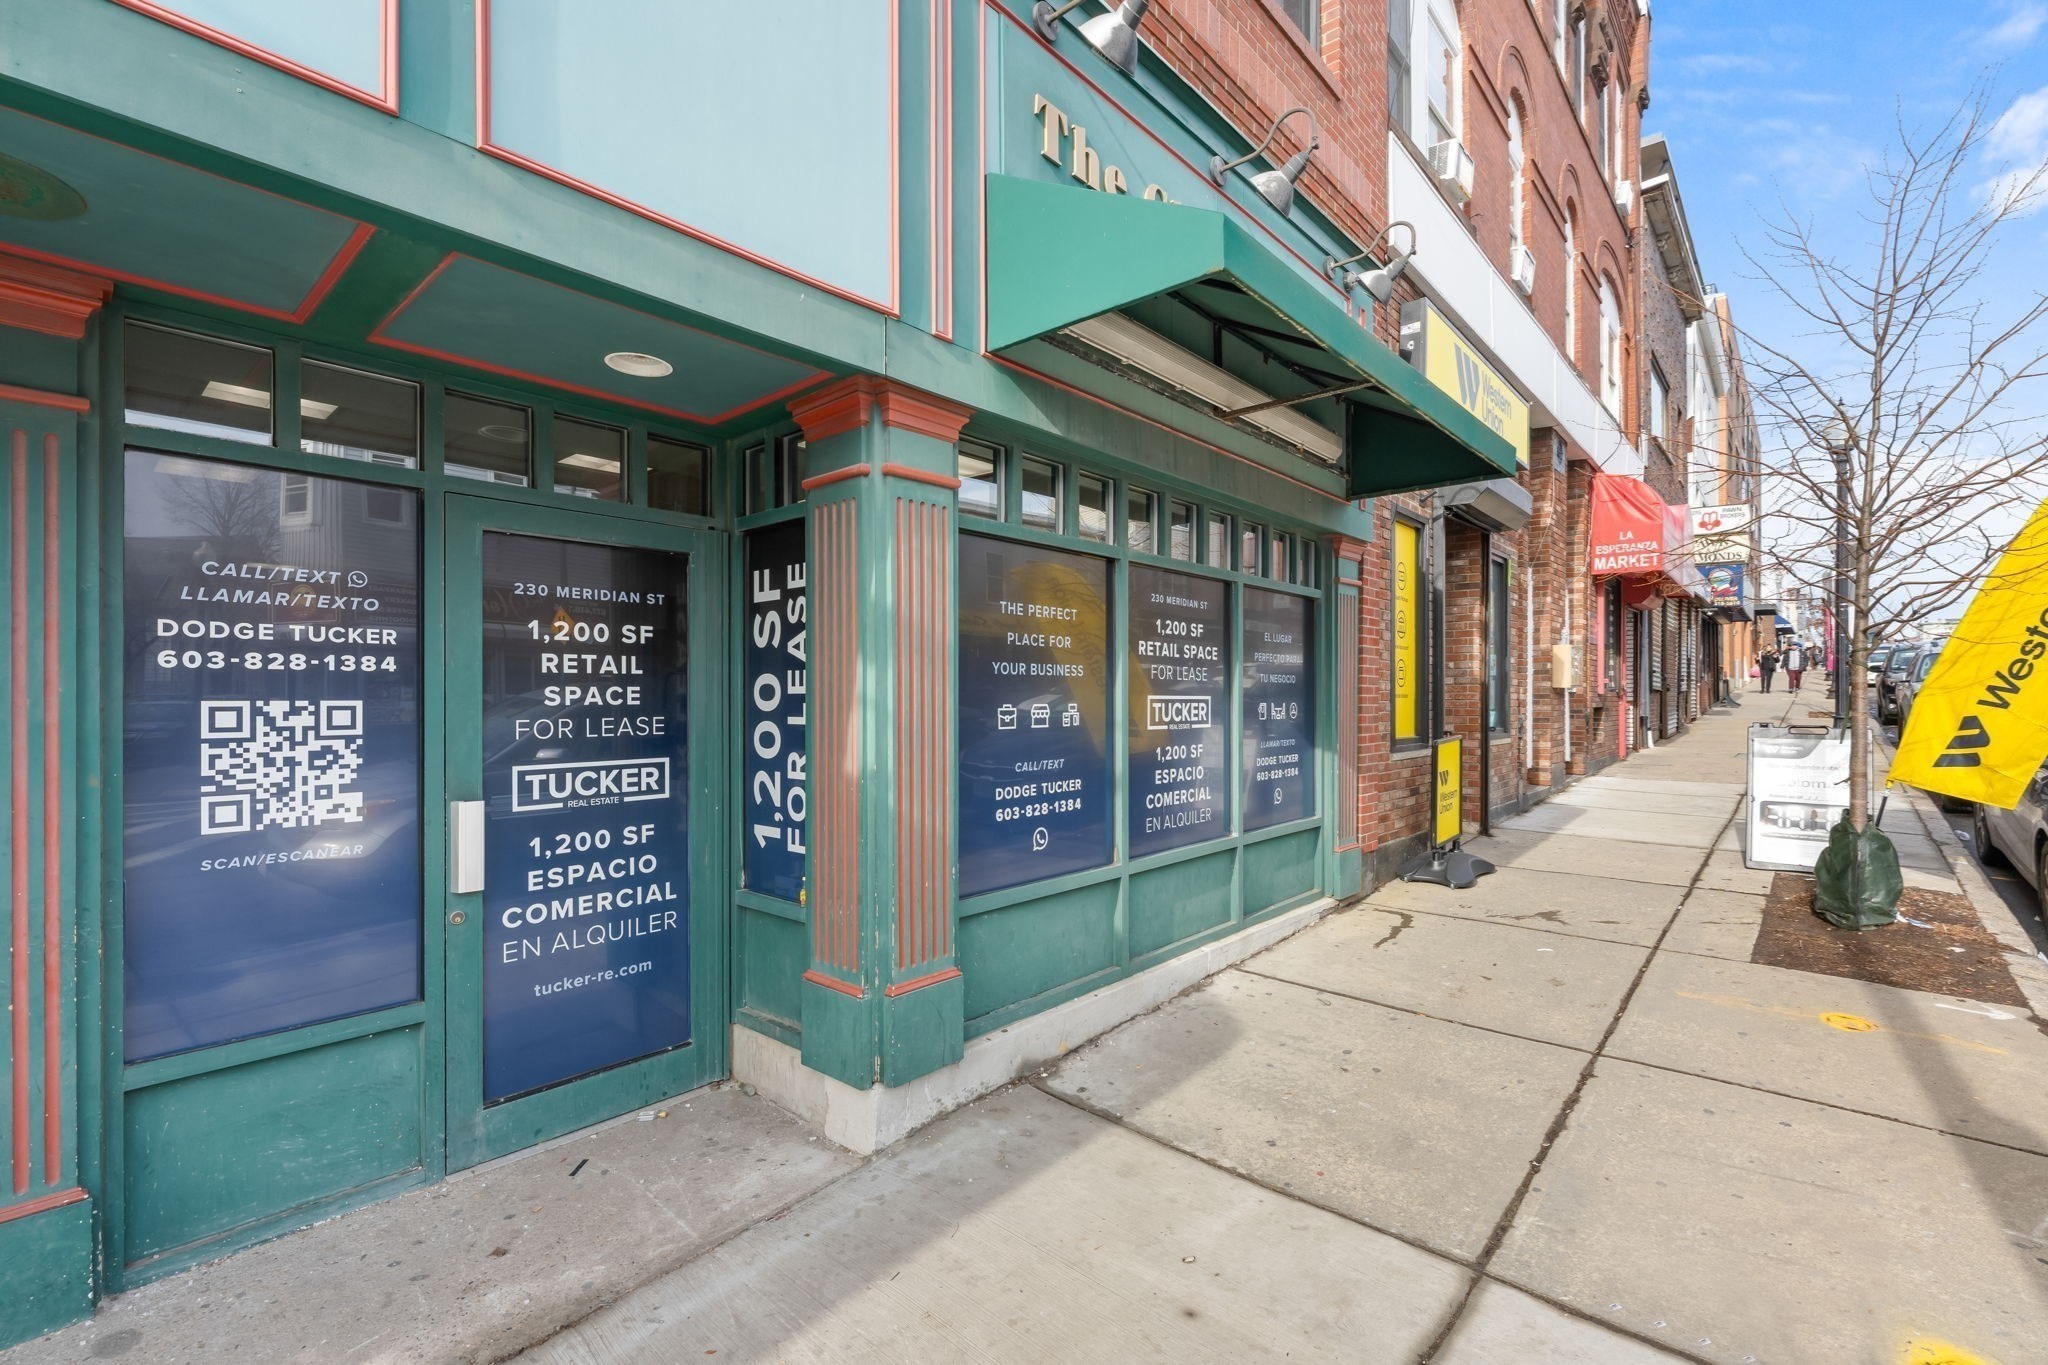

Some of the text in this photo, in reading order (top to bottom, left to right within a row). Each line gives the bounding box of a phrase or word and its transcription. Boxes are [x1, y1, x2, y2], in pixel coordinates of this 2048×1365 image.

[1034, 93, 1128, 194] The
[1482, 370, 1512, 420] Western
[1482, 397, 1504, 437] Union
[1620, 530, 1634, 540] LA
[1596, 541, 1658, 554] ESPERANZA
[1594, 552, 1660, 570] MARKET
[201, 561, 342, 585] CALL/TEXT
[181, 586, 380, 611] LLAMAR/TEXTO
[514, 582, 665, 605] 230 MERIDIAN ST
[1151, 594, 1208, 610] 230 MERIDIAN ST
[1000, 601, 1078, 621] THE PERFECT
[157, 618, 397, 645] DODGE TUCKER
[528, 620, 654, 644] 1,200 SF
[1156, 619, 1204, 637] 1,200 SF
[1264, 632, 1292, 644] EL LUGAR
[1008, 632, 1071, 648] PLACE FOR
[1138, 640, 1218, 660] RETAIL SPACE
[157, 650, 397, 672] 603-828-1384
[542, 653, 643, 675] RETAIL
[1254, 652, 1285, 663] PERFECTO
[992, 662, 1084, 677] YOUR BUSINESS
[1151, 664, 1208, 681] FOR LEASE
[1260, 674, 1296, 684] TU NEGOCIO
[544, 686, 640, 706] SPACE
[753, 568, 784, 849] 1,200 SF
[787, 562, 806, 855] FOR LEASE
[1152, 702, 1207, 722] TUCKER
[516, 716, 665, 740] FOR LEASE
[1260, 738, 1296, 748] LLAMAR/TEXTO
[1156, 744, 1204, 763] 1,200 SF
[1256, 754, 1298, 766] DODGE TUCKER
[1015, 759, 1064, 772] CALL/TEXT
[1155, 766, 1204, 785] ESPACIO
[1256, 767, 1298, 781] 603-828-1384
[525, 767, 660, 800] TUCKER
[996, 779, 1082, 800] DODGE TUCKER
[568, 796, 619, 808] REAL ESTATE
[1146, 786, 1211, 809] COMERCIAL
[1440, 789, 1458, 802] Western
[996, 798, 1082, 822] 603-828-1384
[1440, 802, 1453, 814] Union
[1146, 808, 1211, 833] EN ALQUILER
[529, 824, 655, 859] 1,200 SF
[200, 844, 363, 871] SCAN/ESCANEAR
[528, 854, 657, 892] ESPACIO
[502, 882, 677, 928] COMERCIAL
[504, 910, 677, 964] EN ALQUILER
[534, 960, 652, 997] tucker-re.com
